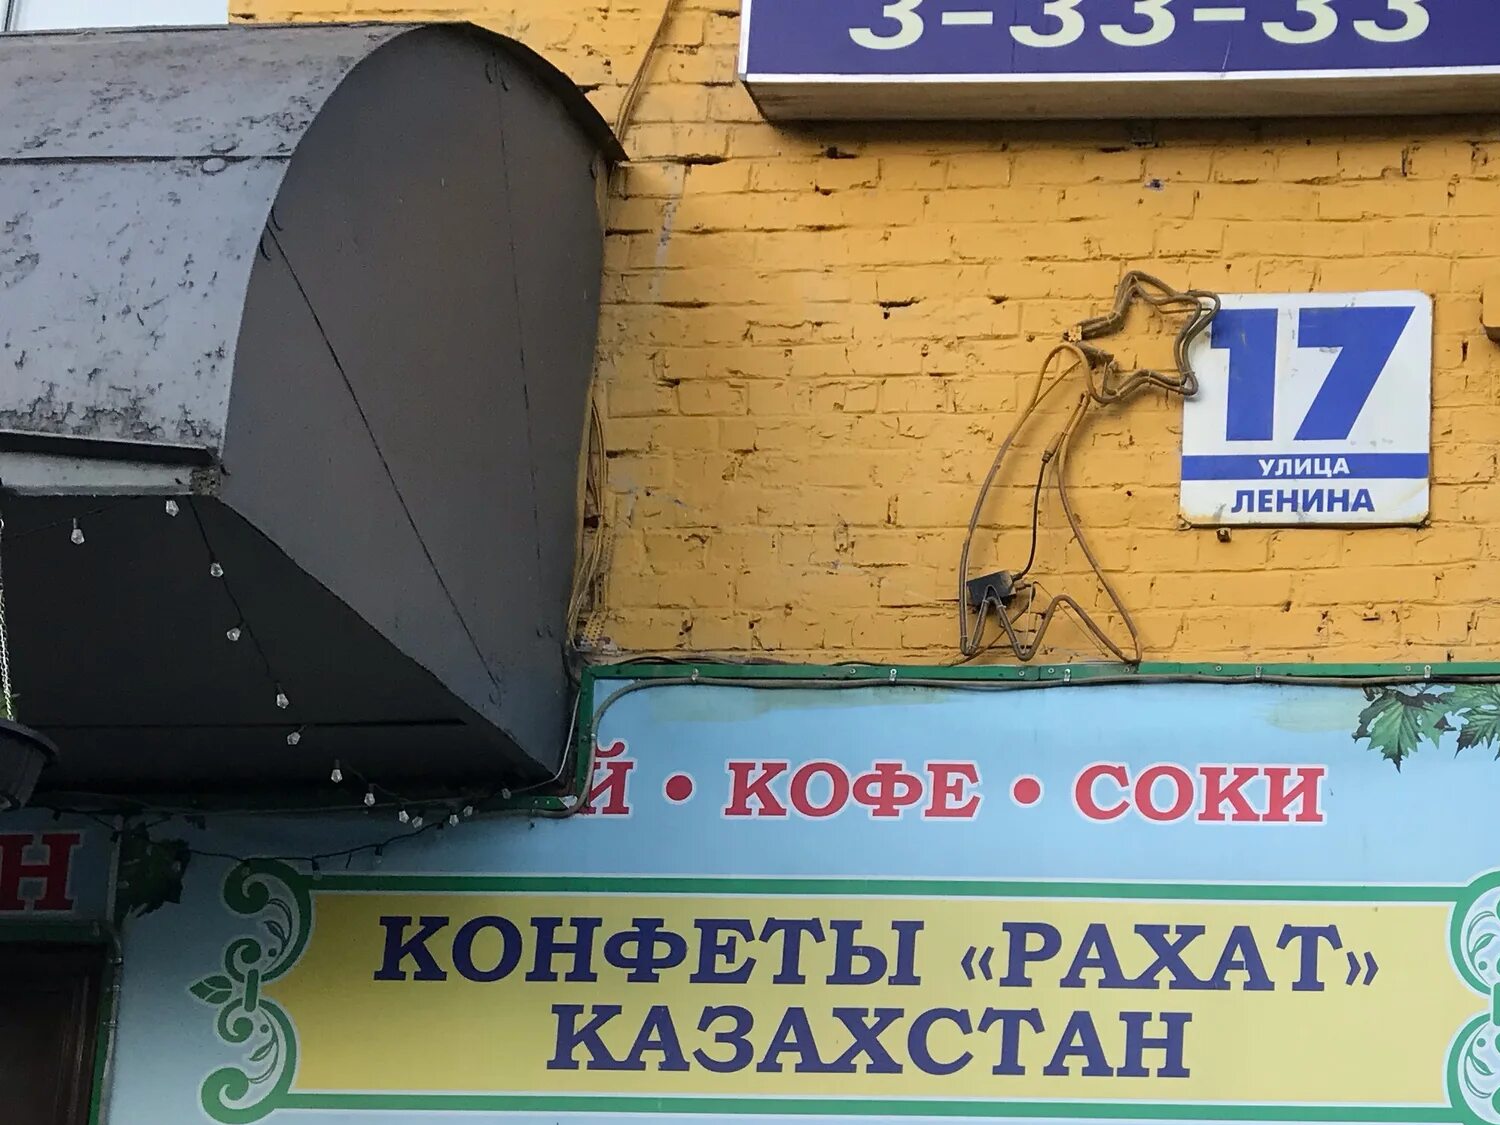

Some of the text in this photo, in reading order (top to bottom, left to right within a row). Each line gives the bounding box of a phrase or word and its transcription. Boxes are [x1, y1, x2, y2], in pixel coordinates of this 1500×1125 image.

[1211, 306, 1415, 441] 17
[1231, 488, 1375, 513] ЛЕНИНА
[1258, 457, 1350, 478] УЛИЦА
[724, 761, 981, 818] КОФЕ
[1075, 766, 1326, 822] СОКИ
[373, 915, 1379, 991] КОНФЕТЫ «РАХАТ»
[546, 1004, 1192, 1078] КАЗАХСТАН
